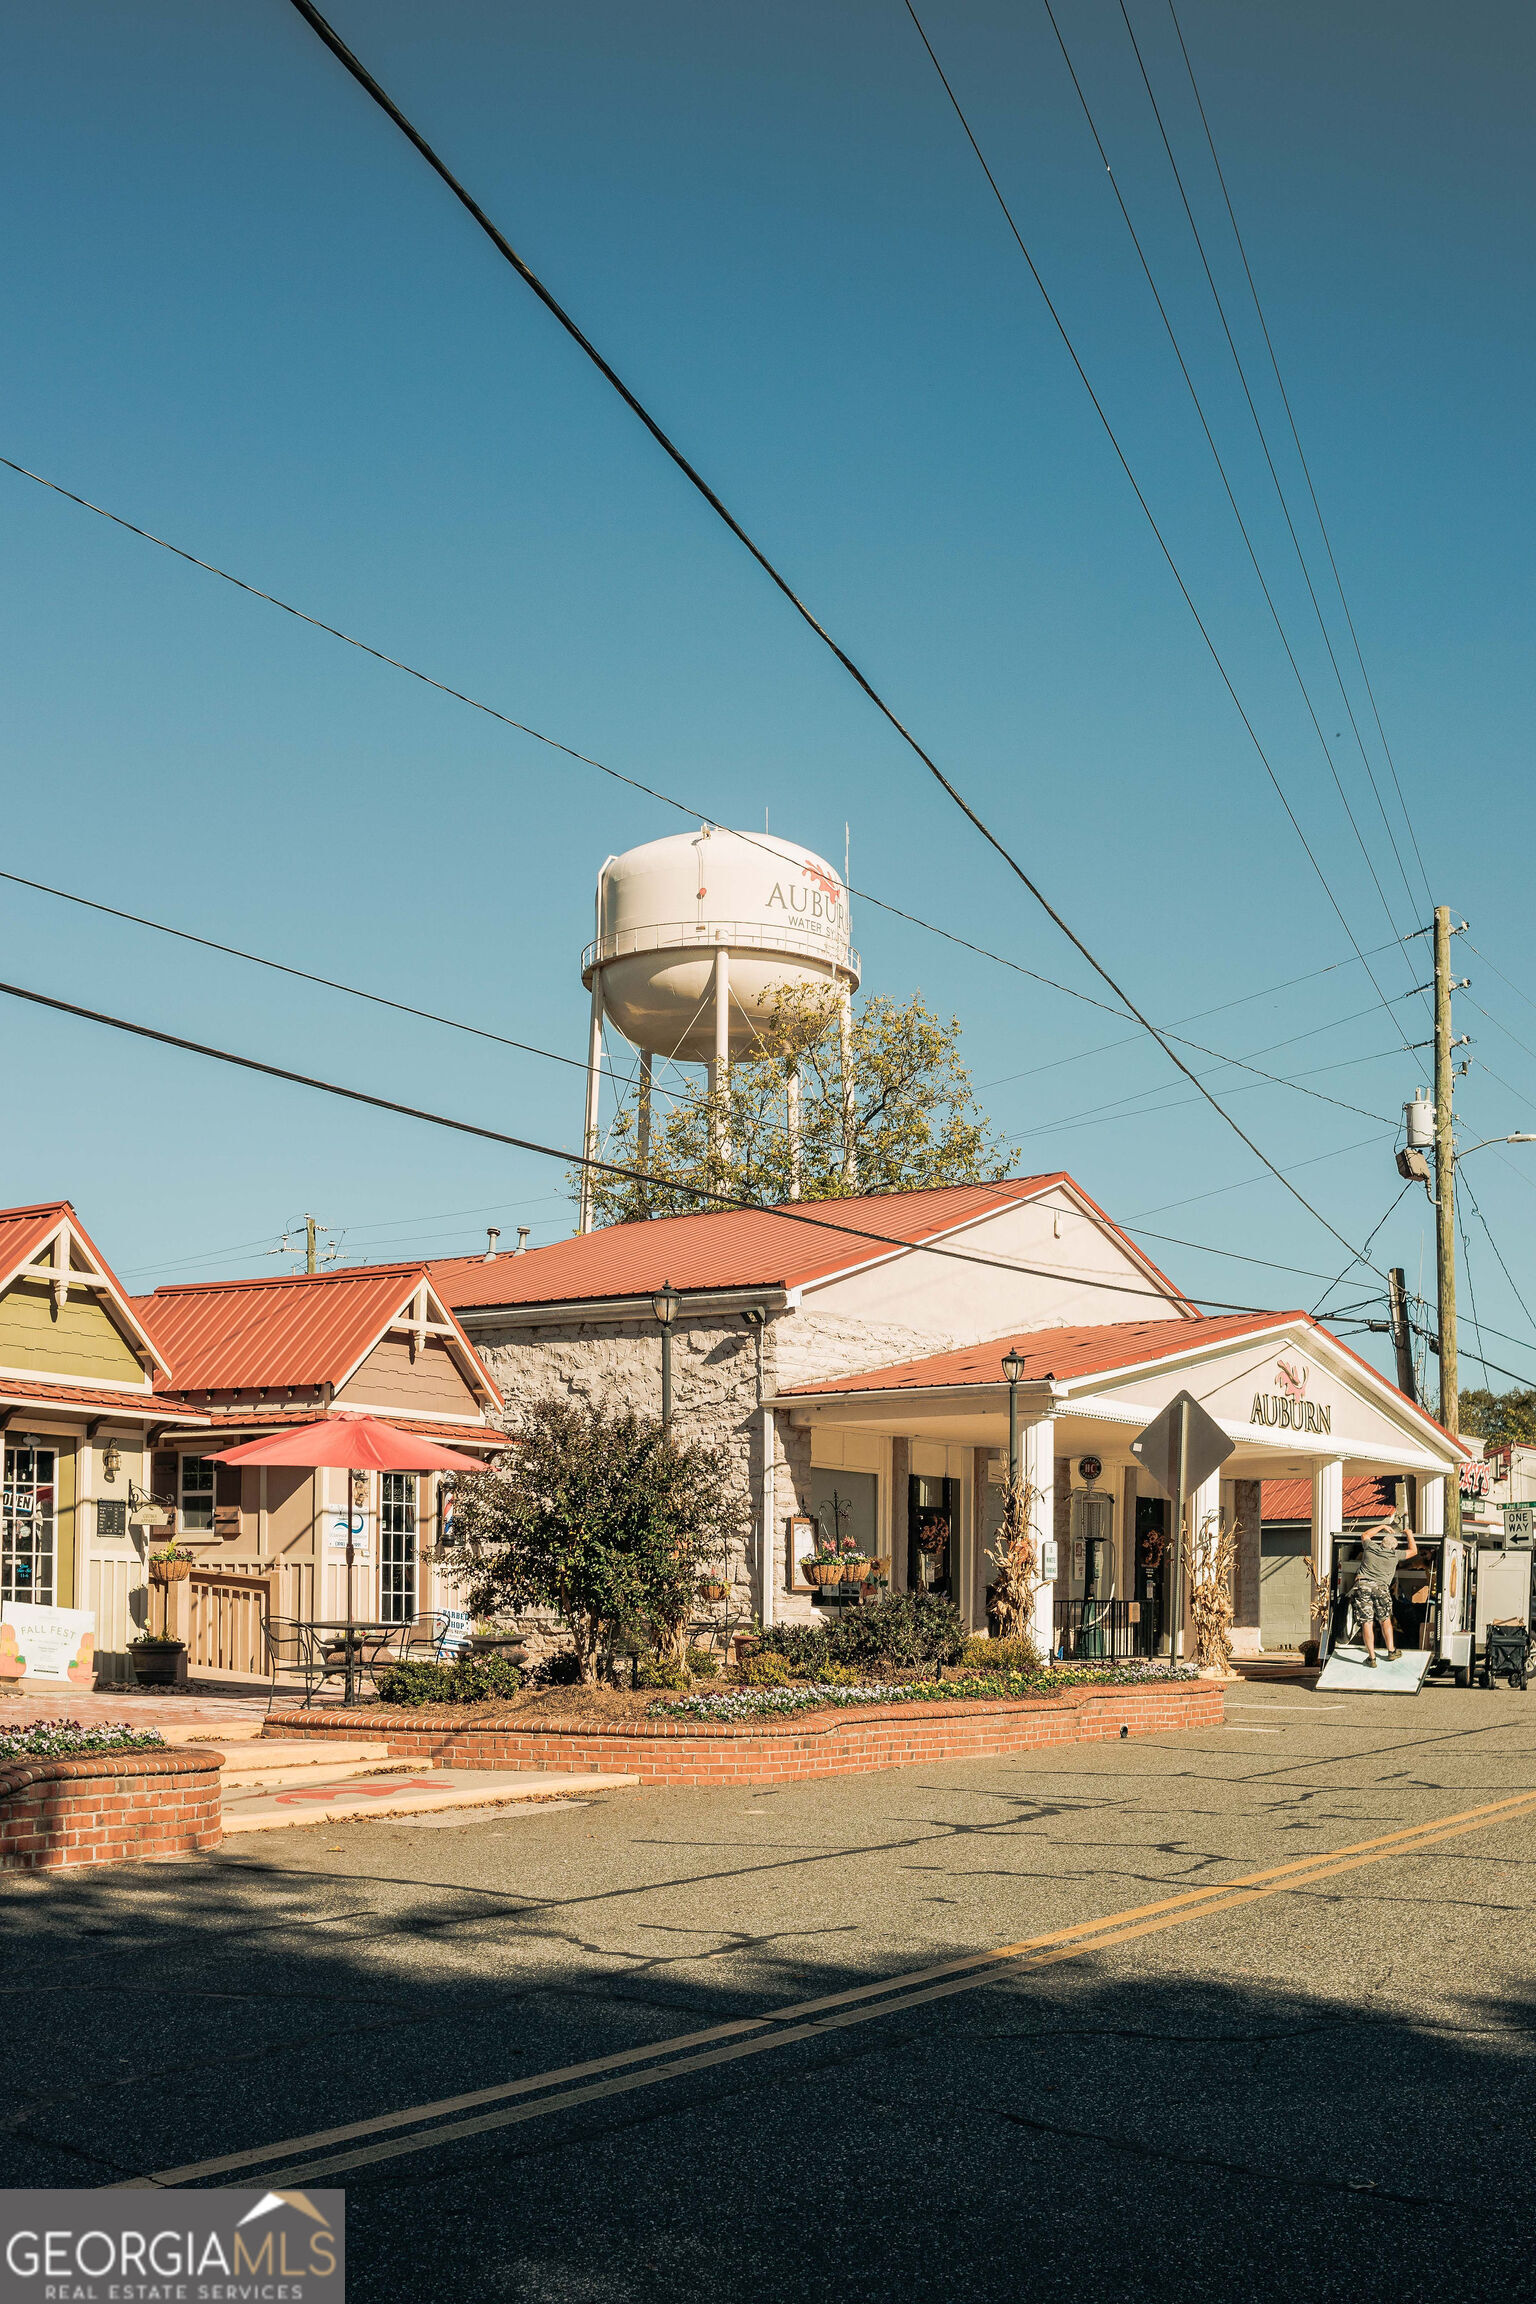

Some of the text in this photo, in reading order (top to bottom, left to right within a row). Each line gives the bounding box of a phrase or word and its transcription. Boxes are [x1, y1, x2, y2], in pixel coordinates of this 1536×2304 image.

[765, 882, 848, 935] AUBUR
[788, 915, 822, 933] WATER
[1249, 1392, 1331, 1435] AUBURN
[1509, 1513, 1528, 1522] ONE
[1509, 1523, 1529, 1532] WAY
[21, 1625, 76, 1639] FALL FEST
